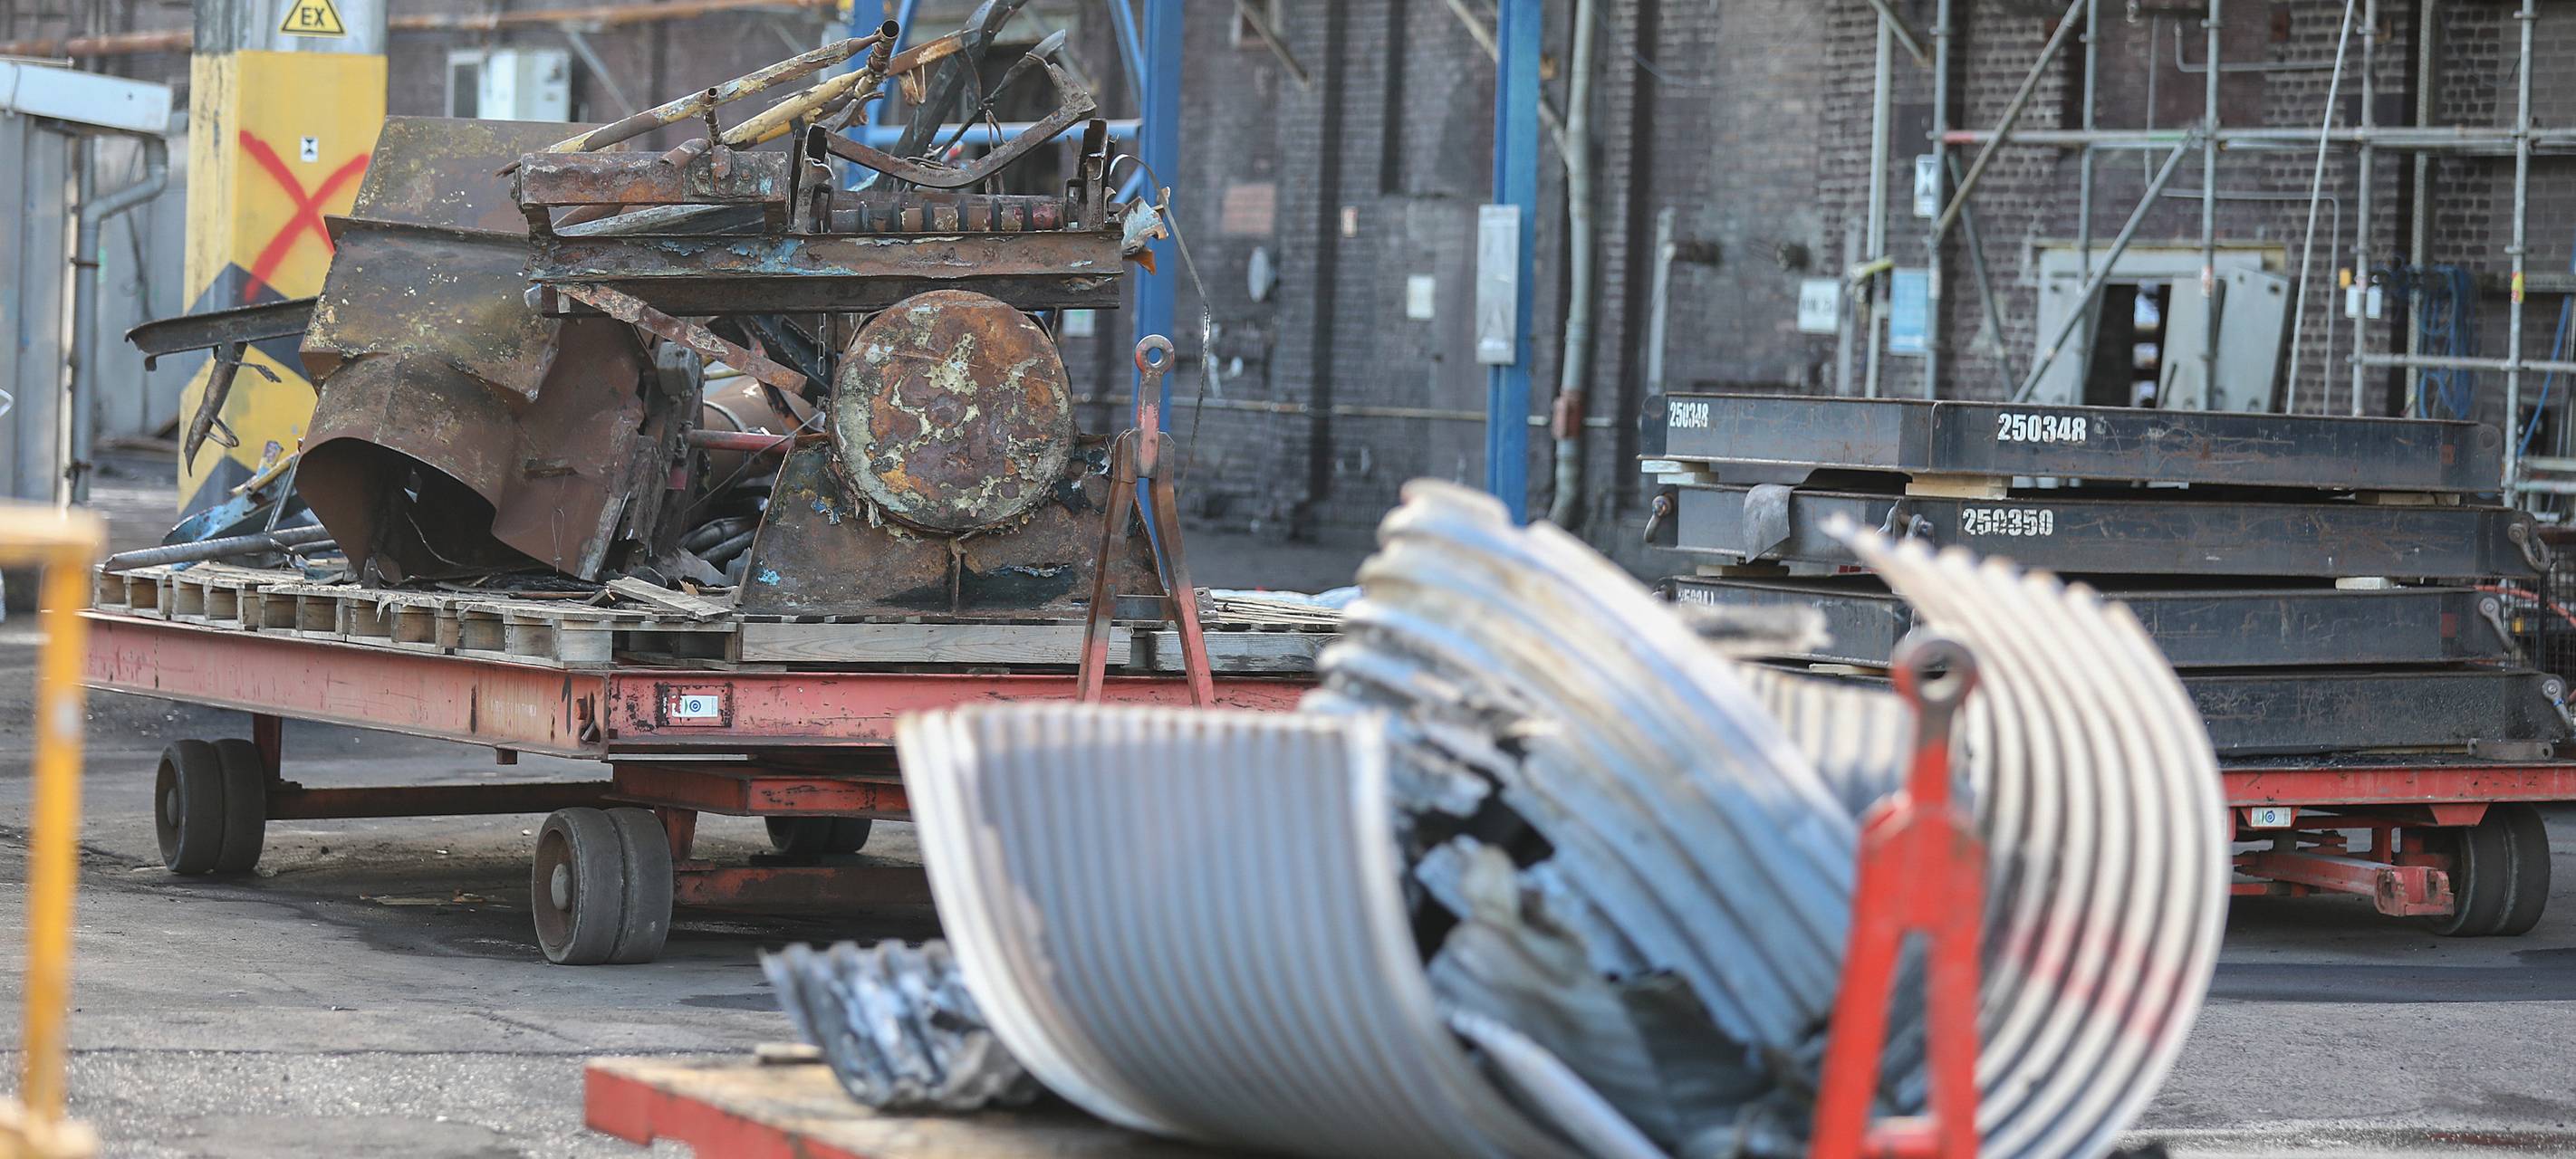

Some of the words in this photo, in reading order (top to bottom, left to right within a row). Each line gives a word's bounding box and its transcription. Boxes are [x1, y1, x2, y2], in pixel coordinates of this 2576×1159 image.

[302, 7, 324, 25] EX
[1669, 401, 1709, 427] 250348
[1997, 413, 2087, 443] 250348
[1962, 508, 2053, 536] 250350
